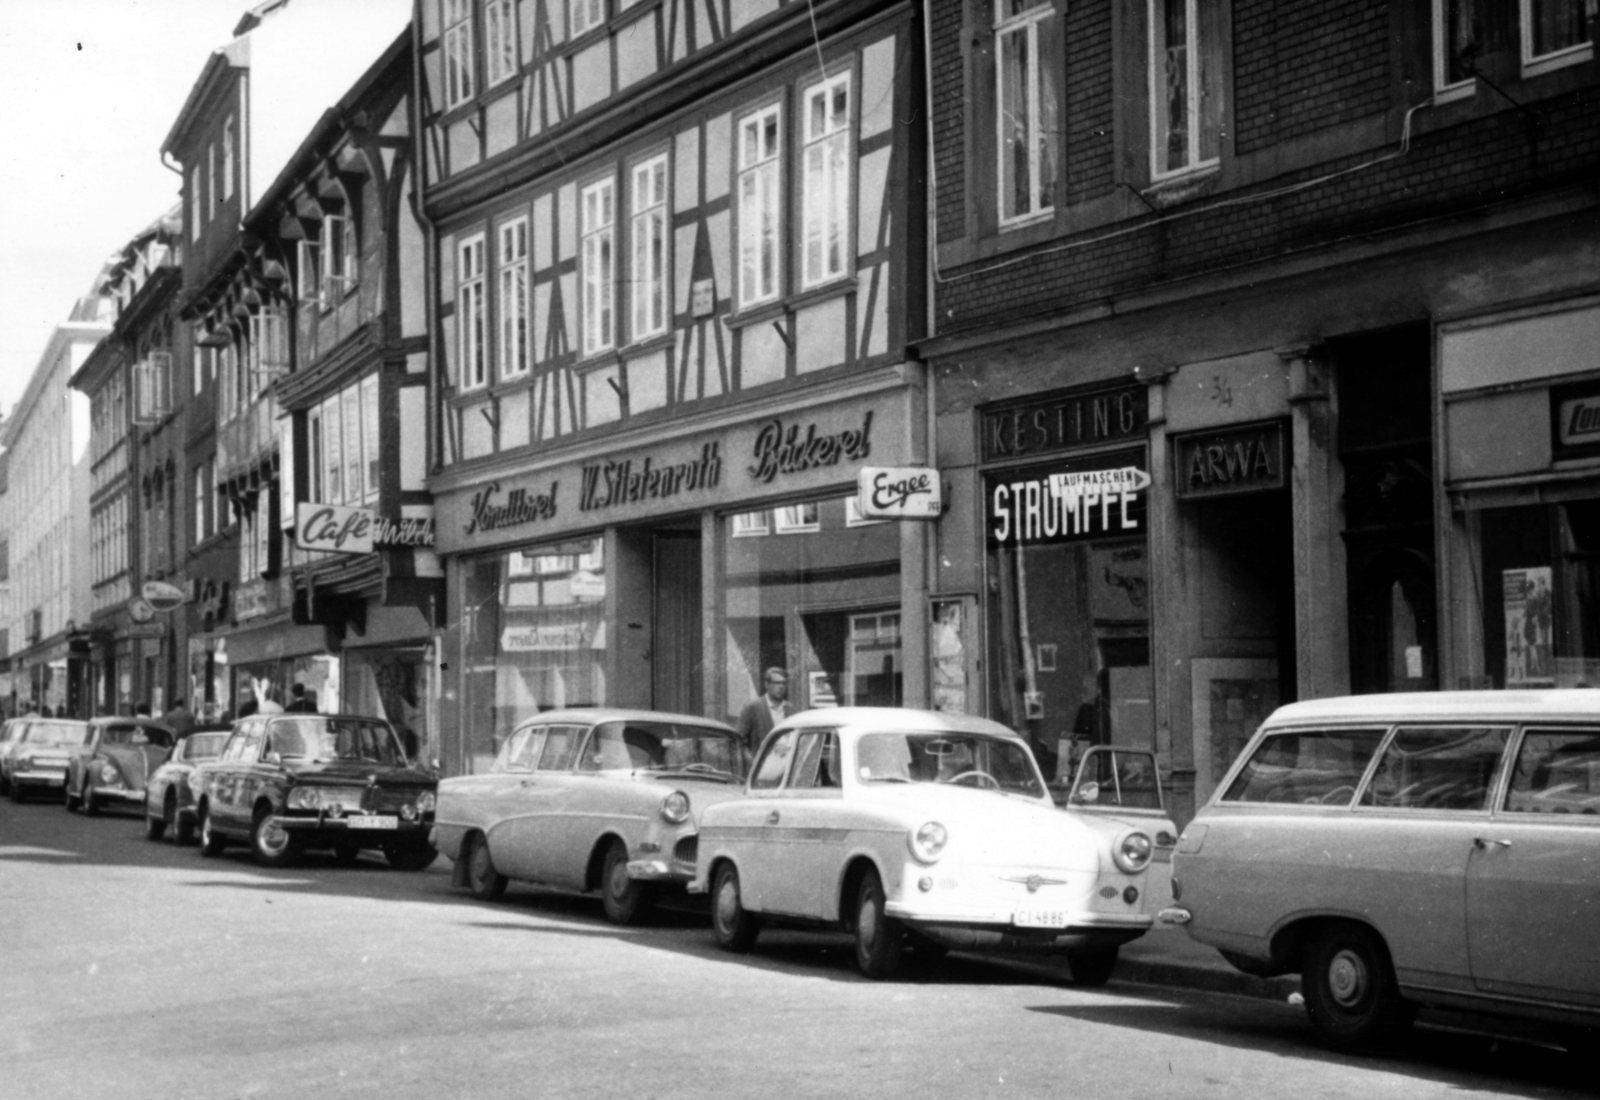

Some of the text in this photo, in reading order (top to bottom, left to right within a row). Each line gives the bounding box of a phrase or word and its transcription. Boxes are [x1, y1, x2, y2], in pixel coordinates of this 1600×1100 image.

[992, 392, 1133, 453] KESTING
[747, 410, 874, 484] Bäckerei
[1190, 439, 1272, 484] ARWA
[872, 472, 932, 510] Ergee
[1057, 470, 1132, 488] LAUFMASCHEN
[302, 507, 371, 549] Café
[374, 516, 435, 546] Milch
[993, 479, 1138, 542] STRÜMPFE
